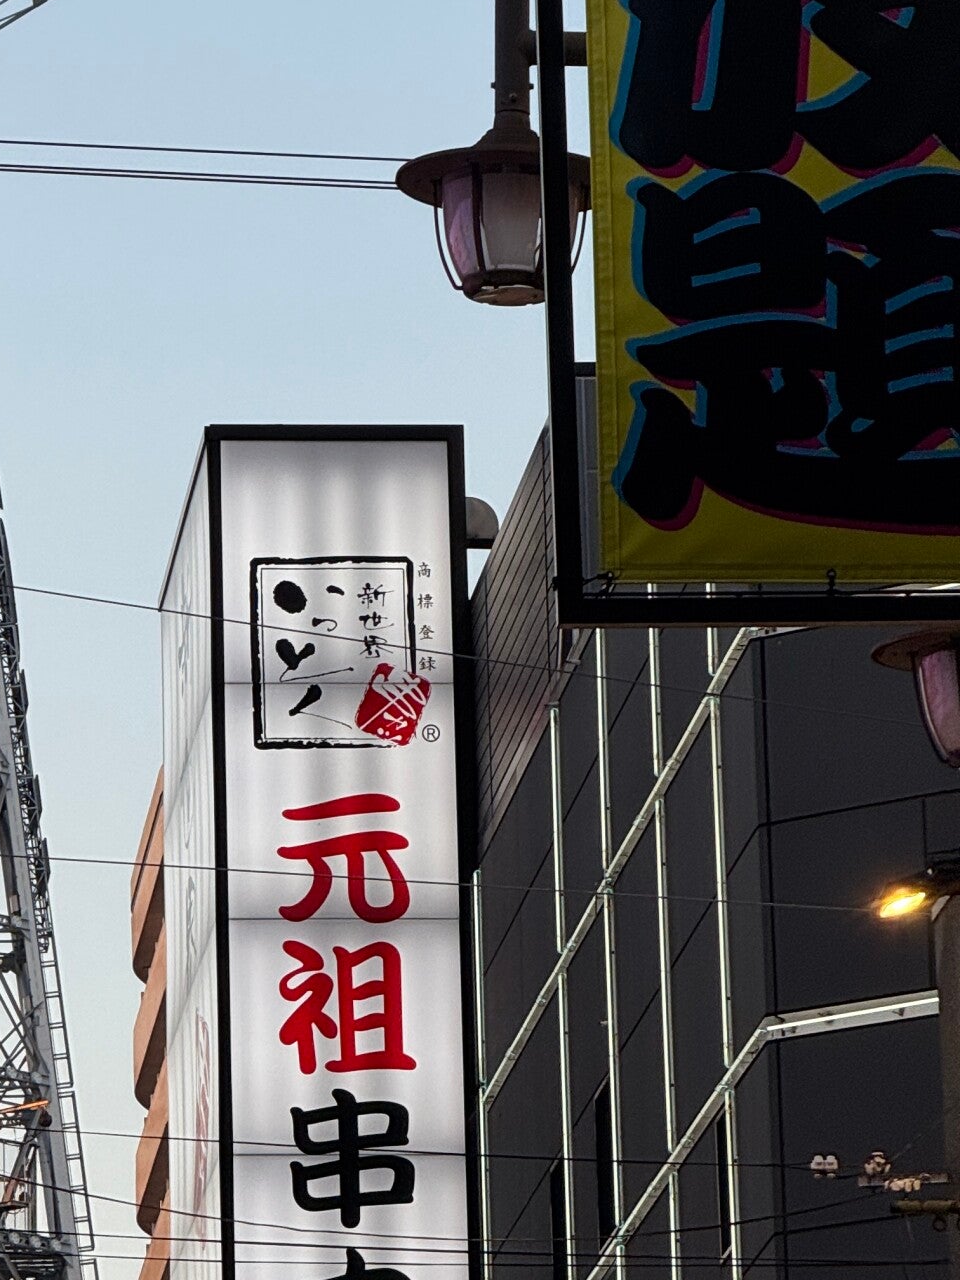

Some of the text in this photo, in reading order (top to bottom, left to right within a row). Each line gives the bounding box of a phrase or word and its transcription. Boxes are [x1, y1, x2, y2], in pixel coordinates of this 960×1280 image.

[357, 582, 394, 659] 新世界
[417, 562, 437, 672] 商標登録
[276, 793, 417, 1280] 元祖串
